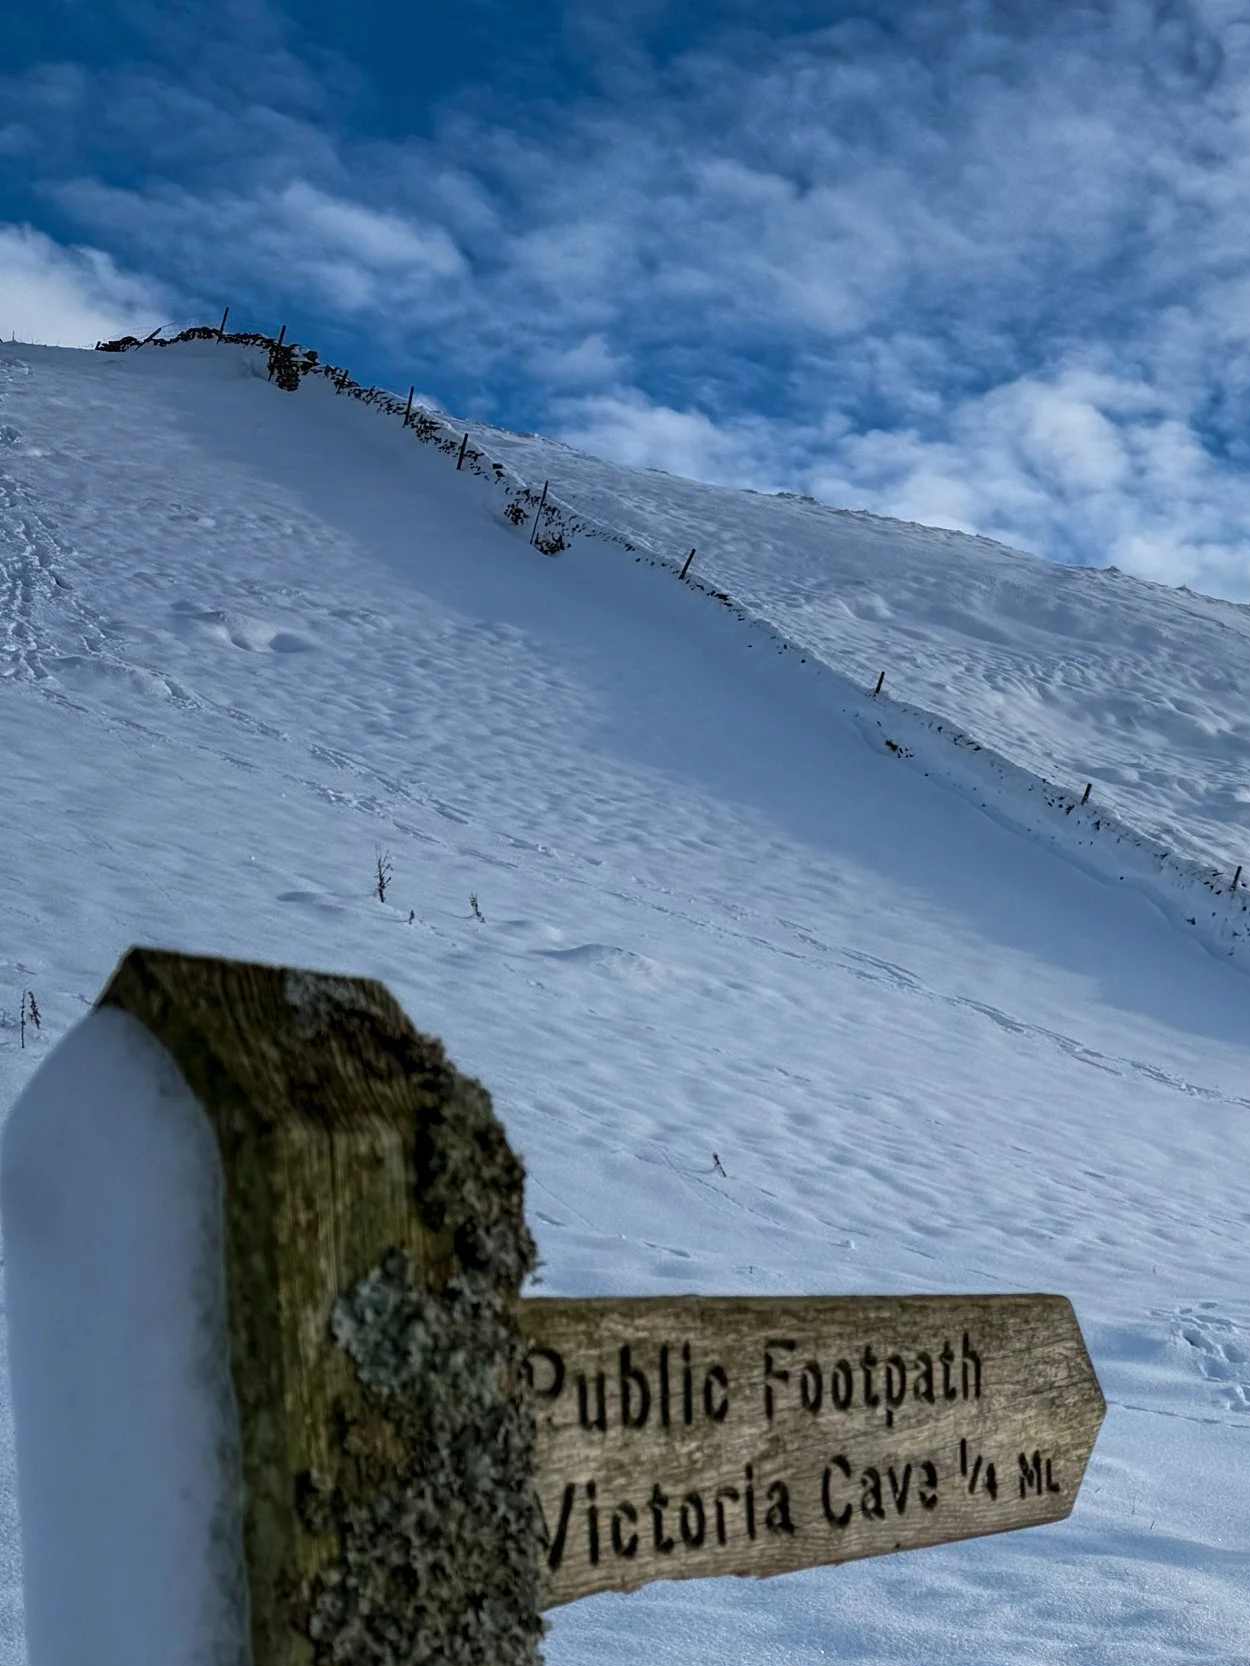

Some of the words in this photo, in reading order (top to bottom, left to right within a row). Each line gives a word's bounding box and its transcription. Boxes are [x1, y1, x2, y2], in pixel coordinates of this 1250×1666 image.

[520, 1340, 728, 1432] Public
[764, 1332, 982, 1428] Footpath
[533, 1463, 795, 1571] Victoria
[822, 1454, 938, 1529] Cave
